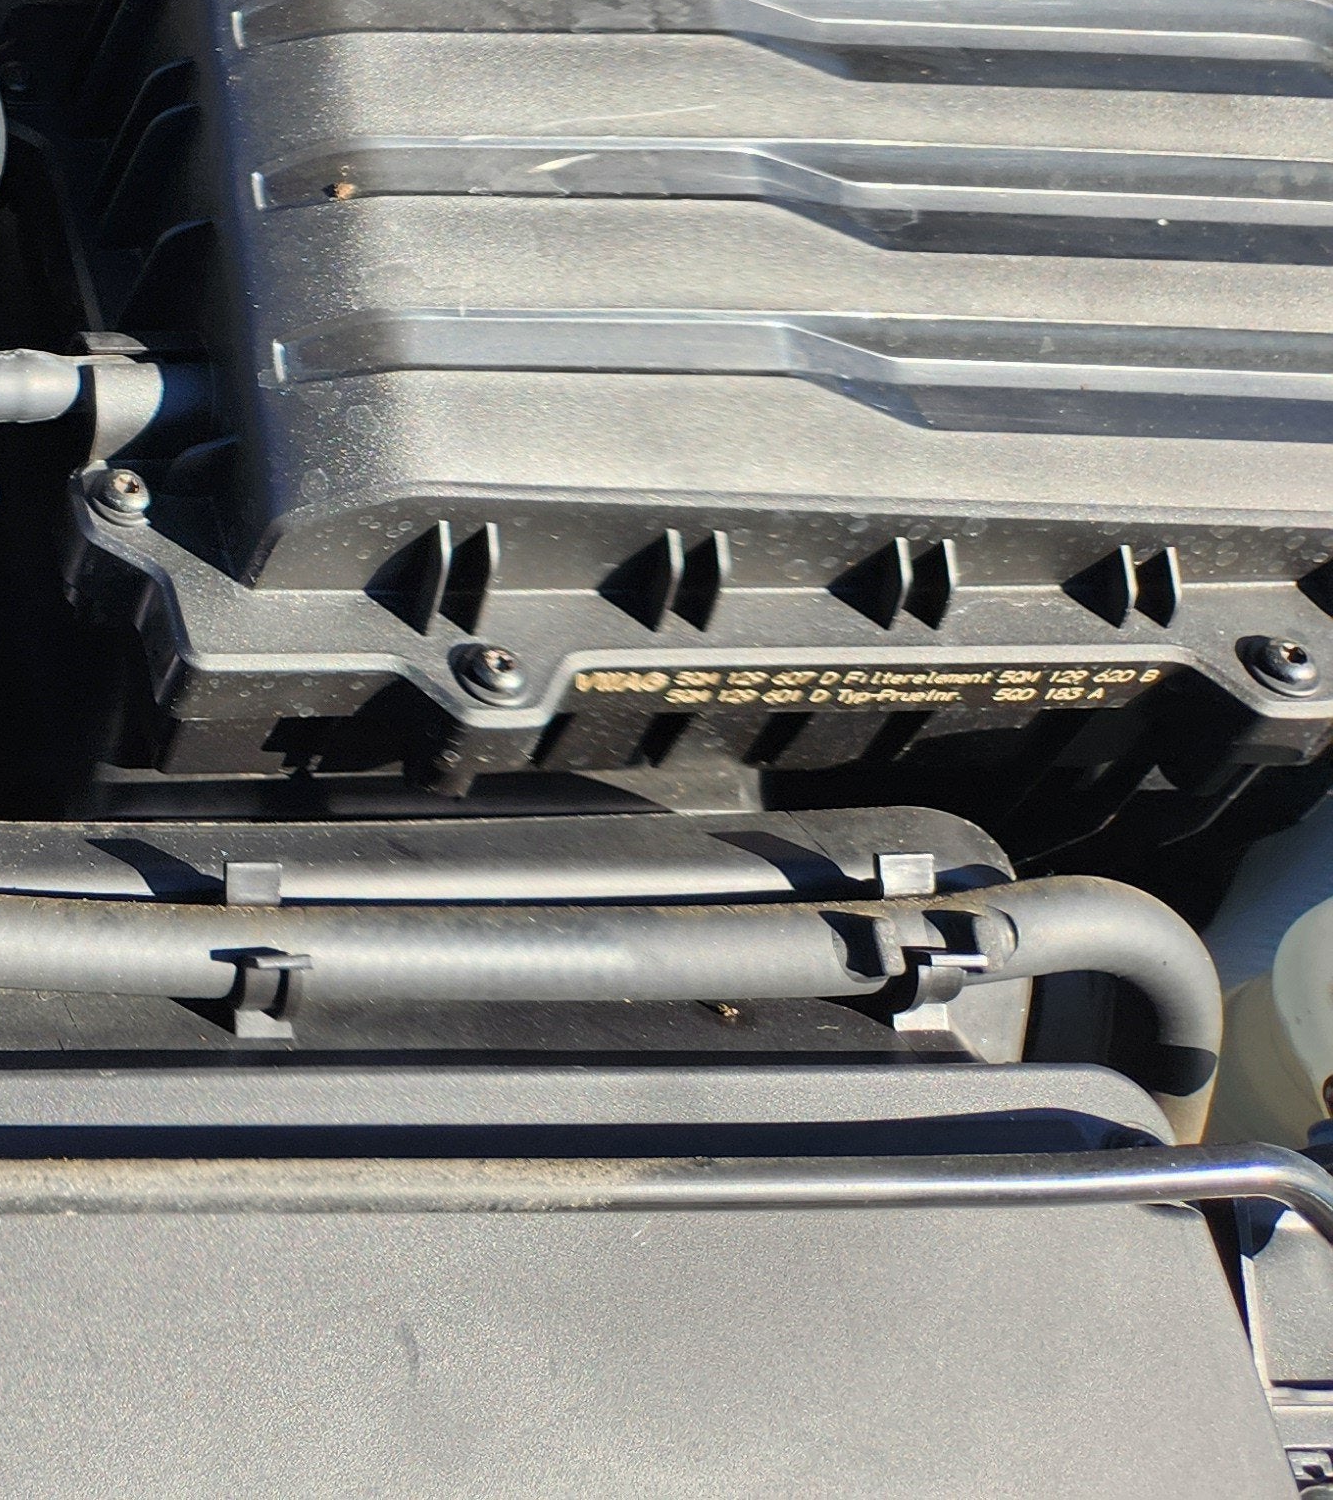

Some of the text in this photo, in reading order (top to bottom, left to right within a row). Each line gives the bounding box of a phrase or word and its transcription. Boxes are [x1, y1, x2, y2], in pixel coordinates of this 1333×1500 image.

[842, 670, 994, 686] Filterelement
[995, 669, 1042, 685] 5QM
[1049, 669, 1090, 684] 129
[1092, 668, 1135, 683] 620
[1139, 668, 1161, 683] B
[1044, 686, 1086, 701] 183
[1086, 686, 1106, 701] A
